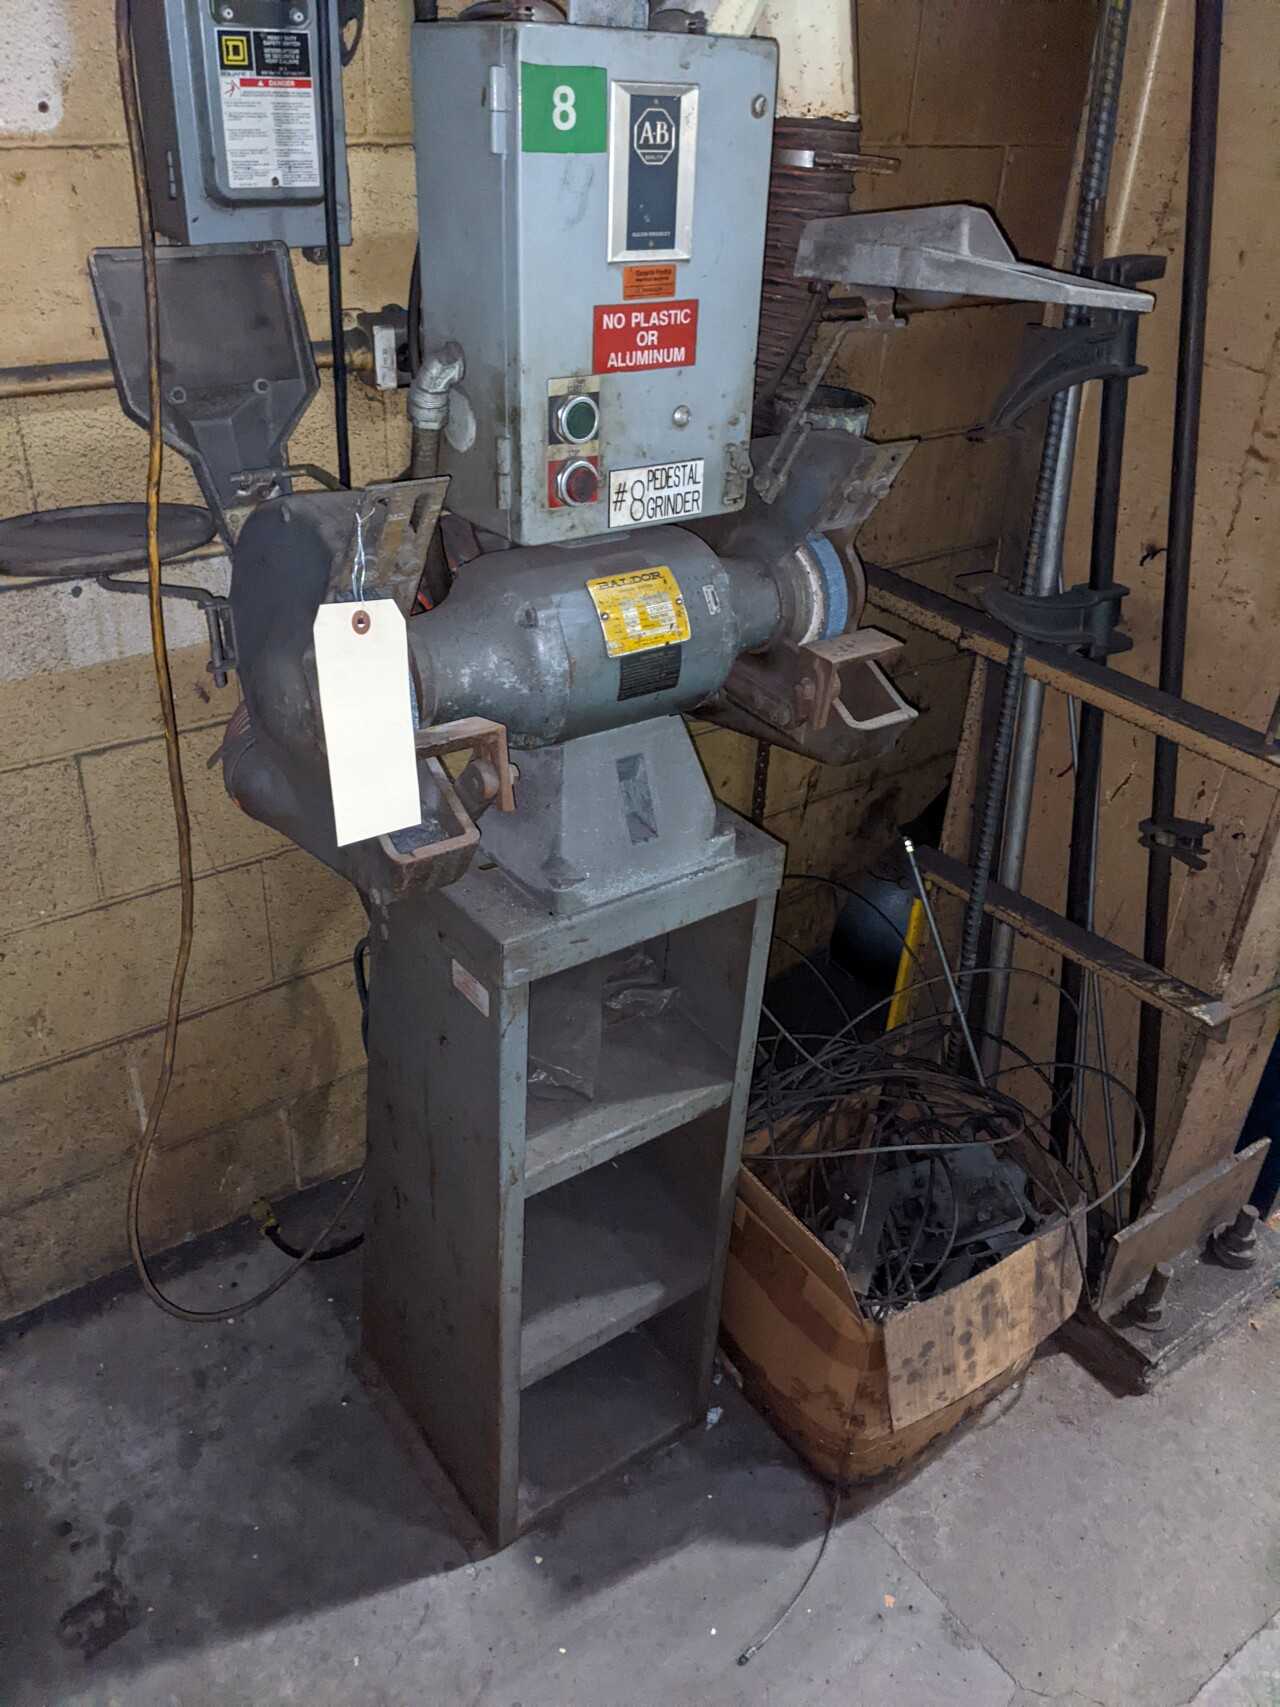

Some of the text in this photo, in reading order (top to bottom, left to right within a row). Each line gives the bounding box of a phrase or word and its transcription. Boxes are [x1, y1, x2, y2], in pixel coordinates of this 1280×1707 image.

[552, 85, 576, 131] 8
[602, 309, 691, 330] NO PLASTIC
[636, 330, 658, 346] OR
[607, 347, 685, 368] ALUMINUM
[646, 463, 701, 491] PEDESTAL
[646, 490, 701, 519] GRINDER
[597, 571, 664, 590] BALDOR
